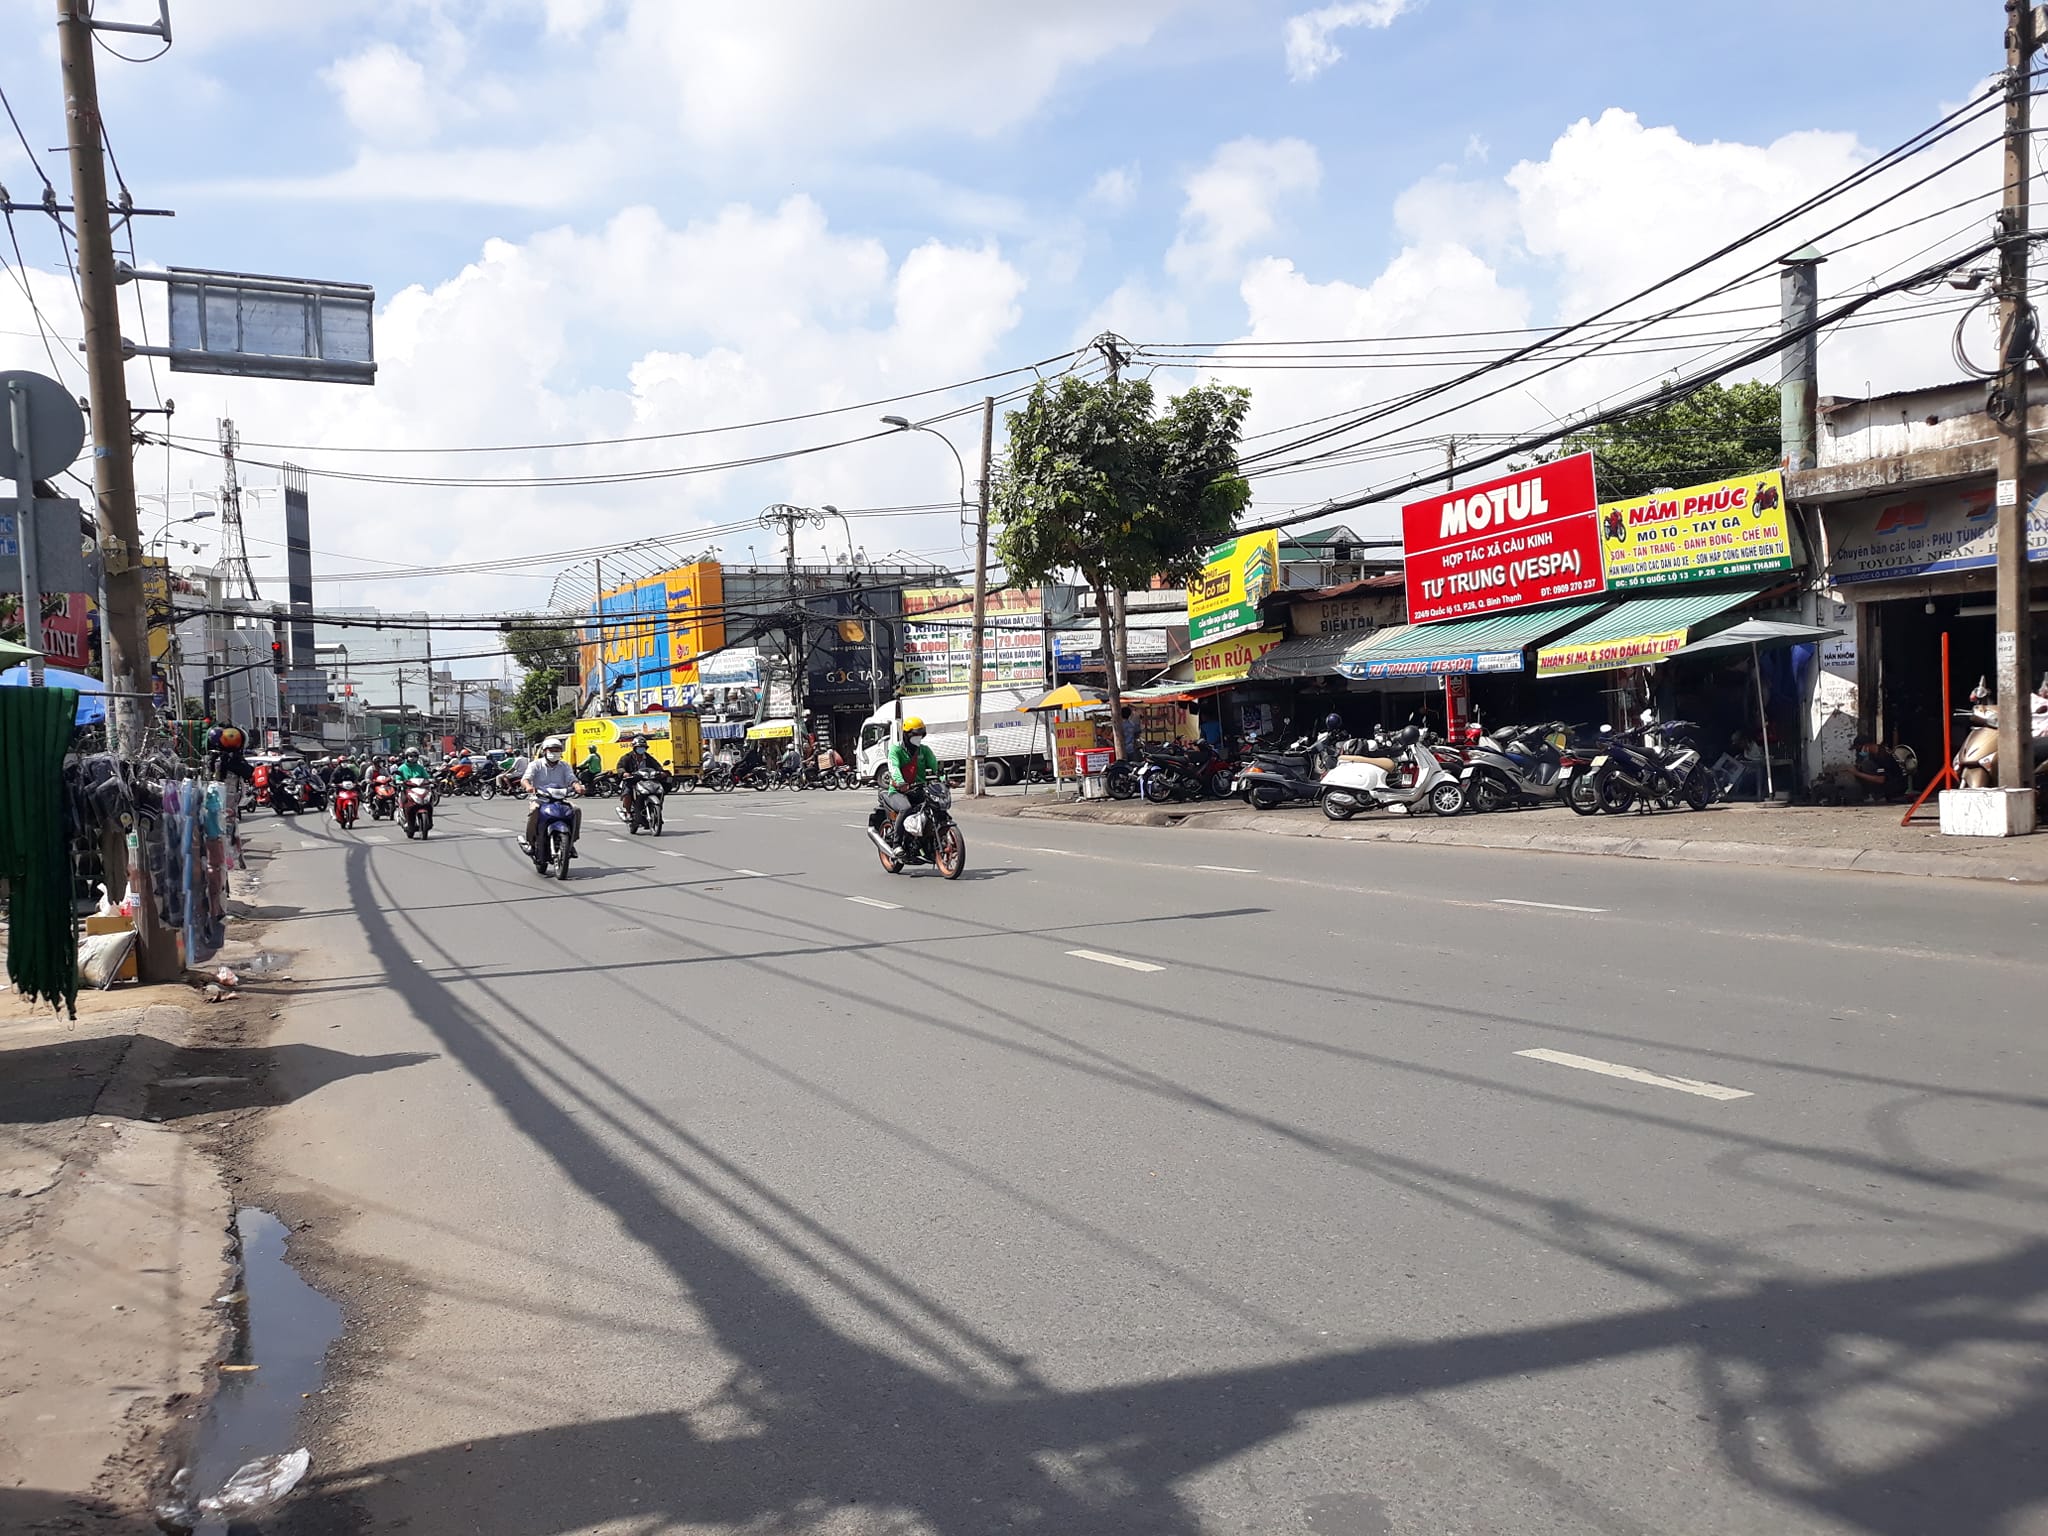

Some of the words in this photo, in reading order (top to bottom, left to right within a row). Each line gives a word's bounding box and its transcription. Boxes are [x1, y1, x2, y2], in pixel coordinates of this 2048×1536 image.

[1440, 477, 1549, 538] MOTUL
[1629, 498, 1679, 526] NĂM
[1683, 486, 1747, 518] PHÚC
[1661, 525, 1677, 539] TÔ
[1692, 519, 1716, 533] TAY
[1722, 516, 1740, 529] GA
[1442, 552, 1463, 569] HỢP
[1465, 546, 1485, 561] TÁC
[1487, 541, 1501, 557] XÃ
[1527, 531, 1553, 549] KINH
[1650, 542, 1676, 555] TRANG
[1837, 544, 1868, 560] Chuyên
[1870, 542, 1887, 556] bán
[1889, 540, 1906, 552] các
[1908, 536, 1925, 553] loại
[1932, 531, 1953, 549] PHỤ
[1858, 554, 1914, 570] TOYOTA
[1421, 577, 1446, 600] TƯ
[1447, 564, 1506, 595] TRUNG
[1509, 549, 1581, 588] (VESPA)
[1646, 574, 1667, 585] QUỐC
[1668, 571, 1678, 583] LỘ
[1680, 571, 1689, 580] 13
[1541, 587, 1552, 597] ĐT:
[1570, 580, 1583, 592] 270
[1583, 578, 1596, 590] 237
[1430, 605, 1446, 616] Quốc
[1501, 593, 1522, 604] Thạnh
[1838, 605, 1847, 615] 7
[1194, 648, 1221, 672] ĐIỂM
[1225, 643, 1253, 668] RỬA
[1386, 660, 1428, 676] TRUNG
[1431, 657, 1473, 673] VESPA
[1541, 652, 1564, 670] NHẬN
[1590, 650, 1597, 662] &
